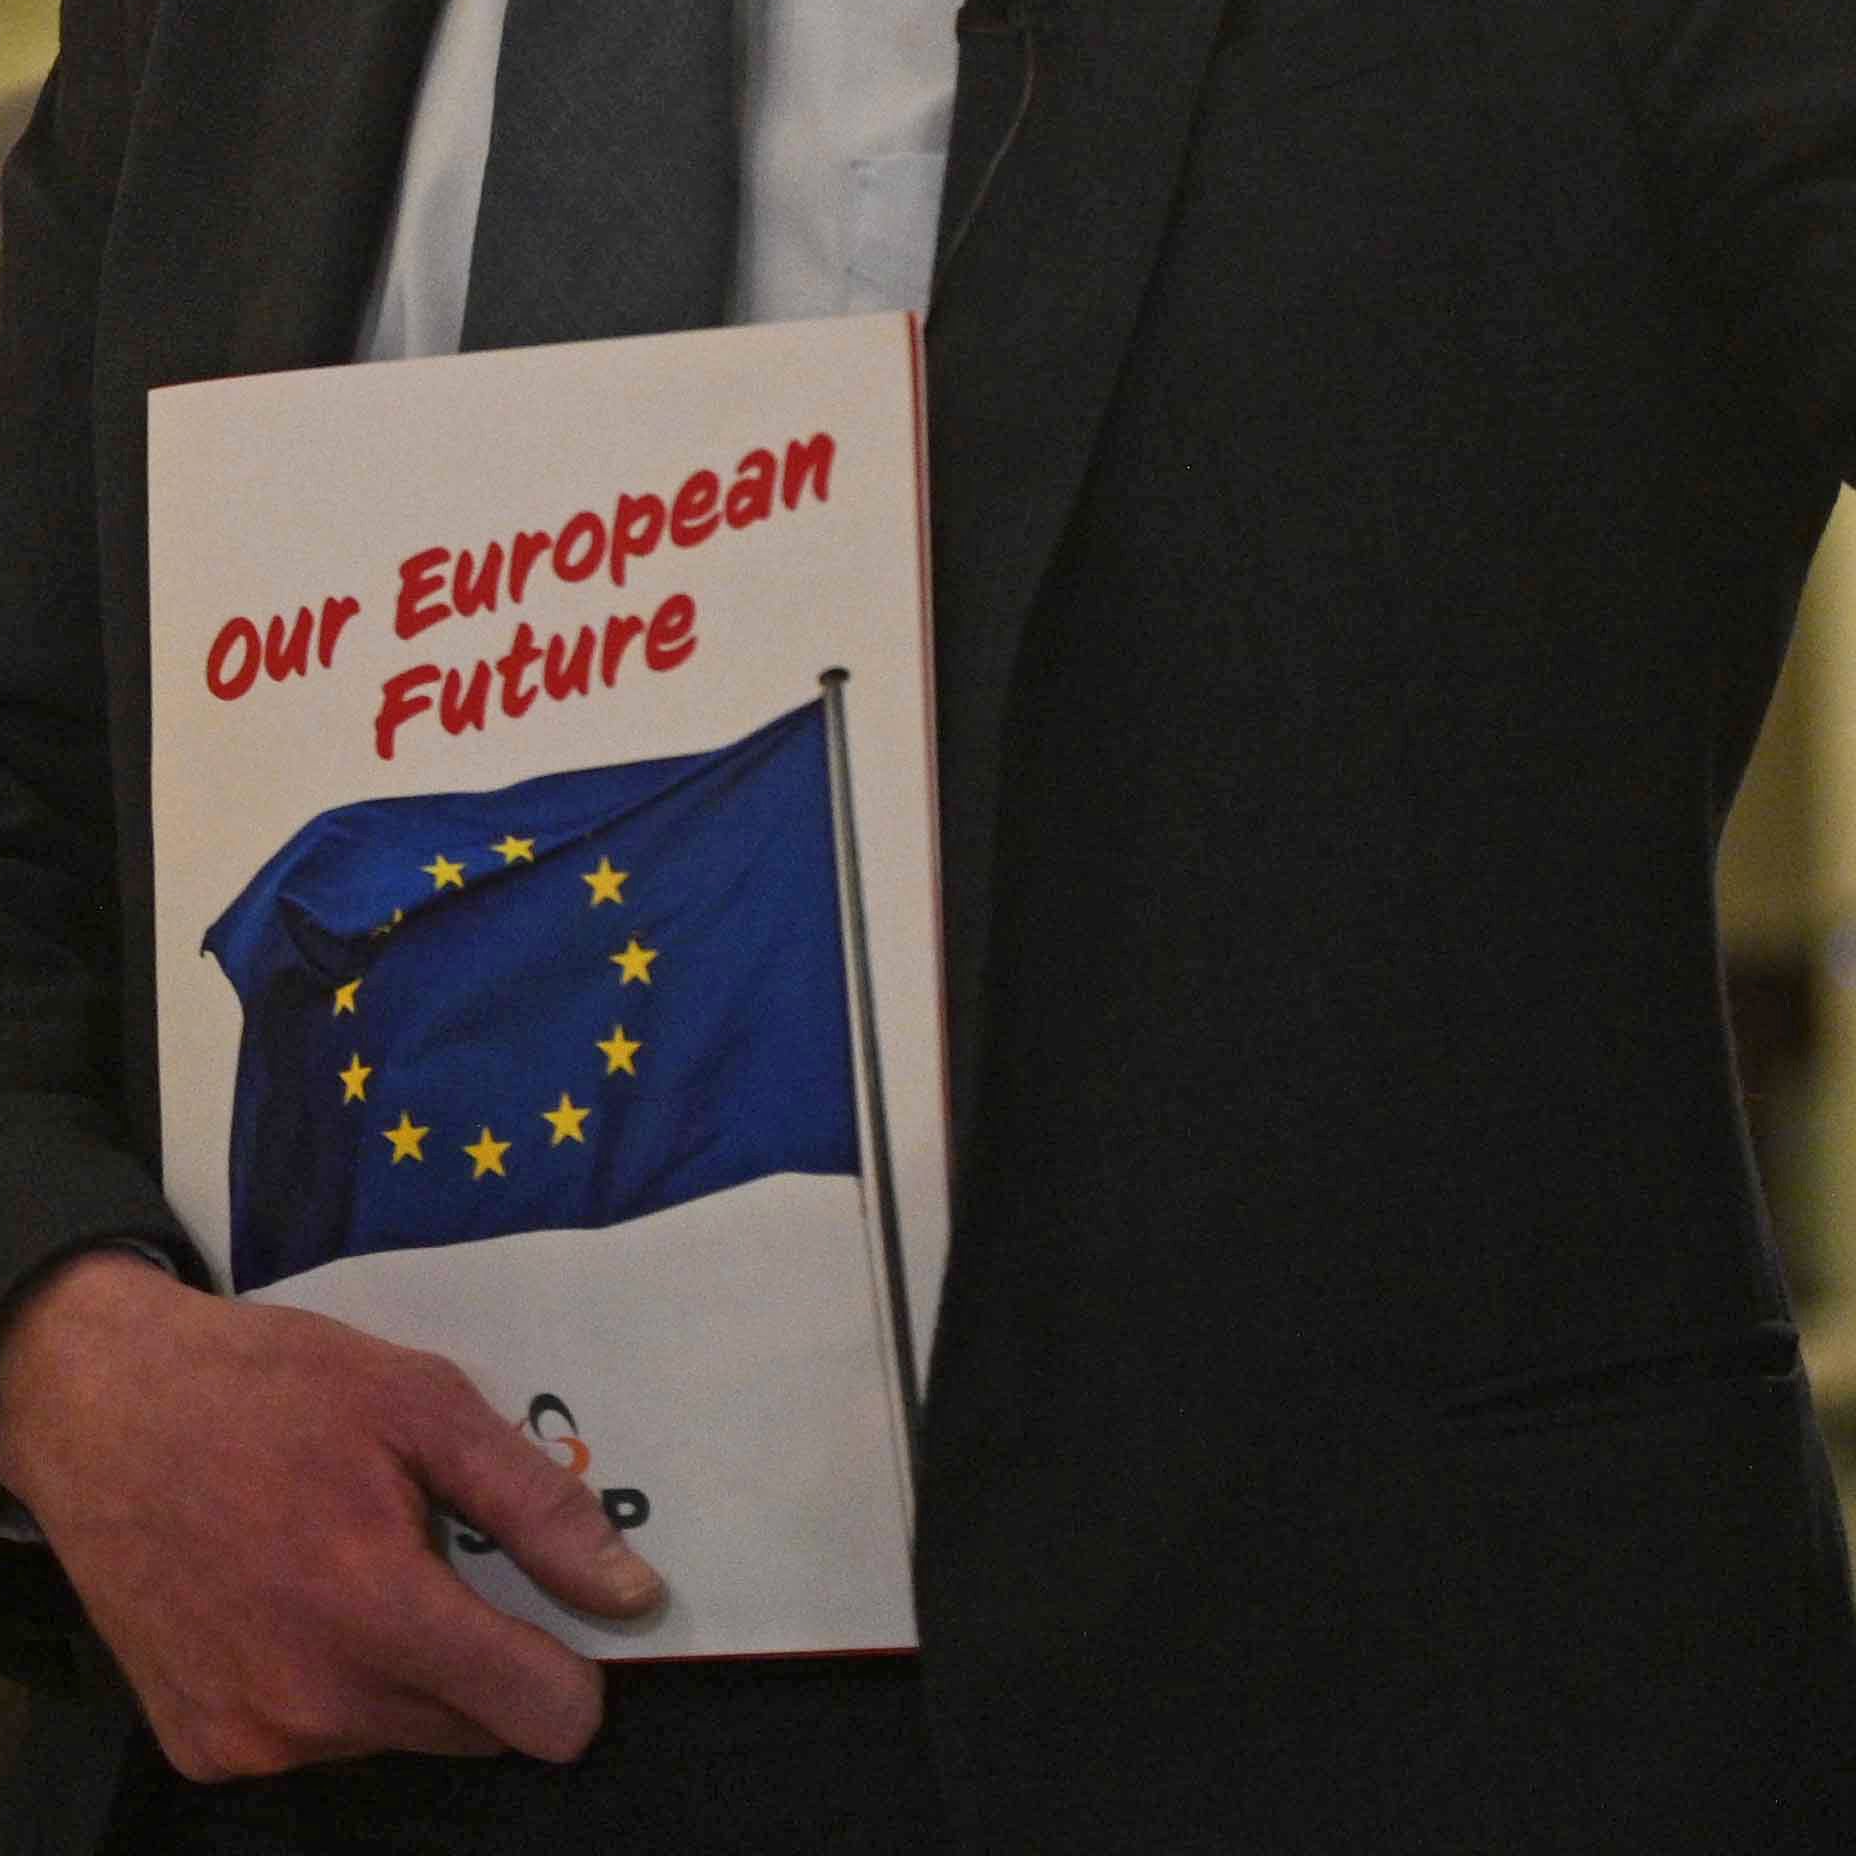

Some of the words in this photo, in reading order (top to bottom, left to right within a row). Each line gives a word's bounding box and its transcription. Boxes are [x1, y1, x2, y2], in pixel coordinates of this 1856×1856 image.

[204, 592, 364, 703] Our
[393, 430, 839, 642] European
[374, 591, 699, 762] Future
